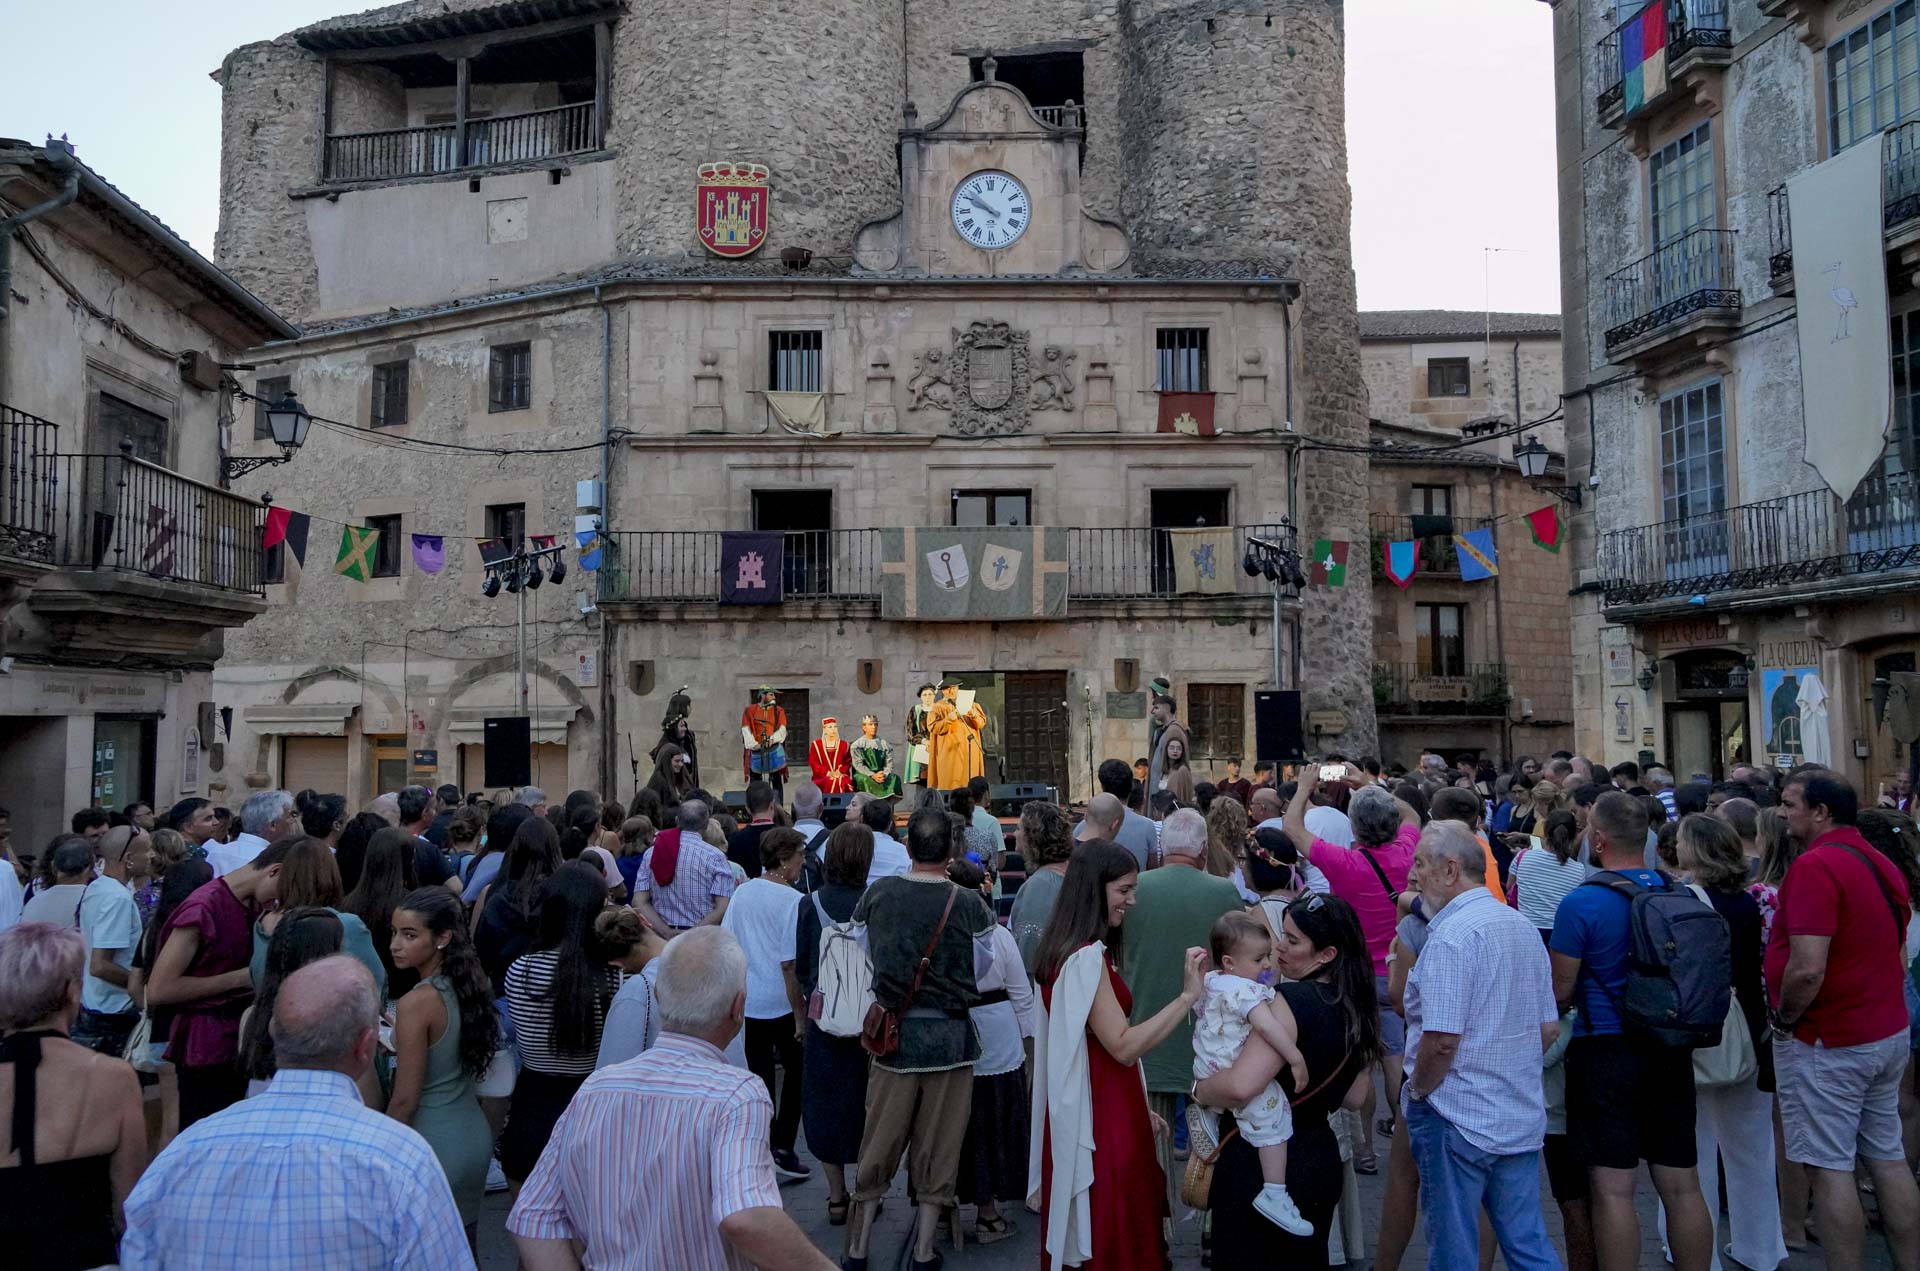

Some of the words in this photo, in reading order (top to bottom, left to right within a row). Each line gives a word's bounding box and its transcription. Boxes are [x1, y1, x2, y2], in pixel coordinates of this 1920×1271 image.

[1661, 623, 1679, 644] LA
[1682, 621, 1729, 646] QUED
[1760, 642, 1775, 668] LA
[1777, 638, 1819, 671] QUEDA
